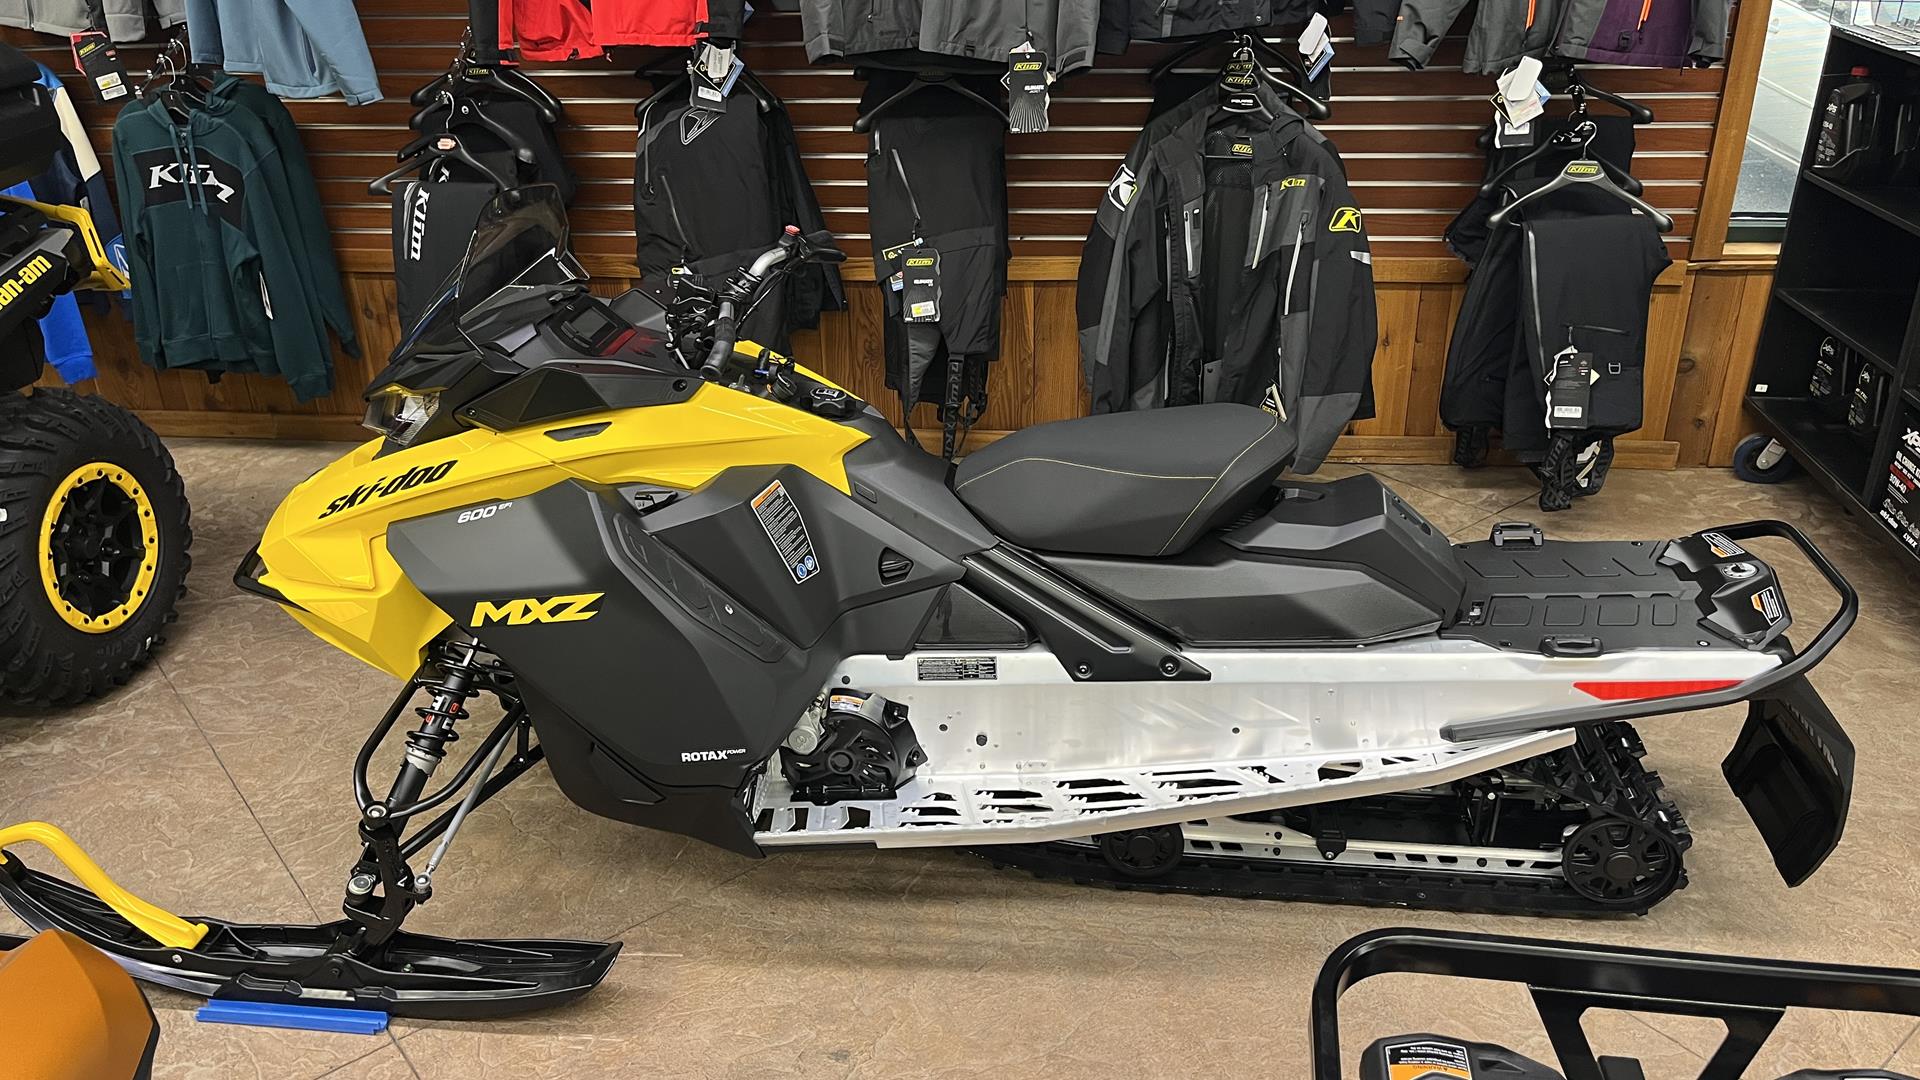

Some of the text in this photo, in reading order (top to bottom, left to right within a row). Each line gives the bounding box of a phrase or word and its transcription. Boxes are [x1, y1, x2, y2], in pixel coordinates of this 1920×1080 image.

[1014, 62, 1042, 71] Klim
[1568, 165, 1598, 174] Klim
[411, 187, 430, 261] Klim
[906, 258, 934, 266] Klim
[0, 255, 53, 311] an-am
[318, 460, 459, 520] ski-doo
[457, 502, 513, 524] 600 EFI
[470, 592, 606, 628] MXZ
[681, 749, 728, 763] ROTAX
